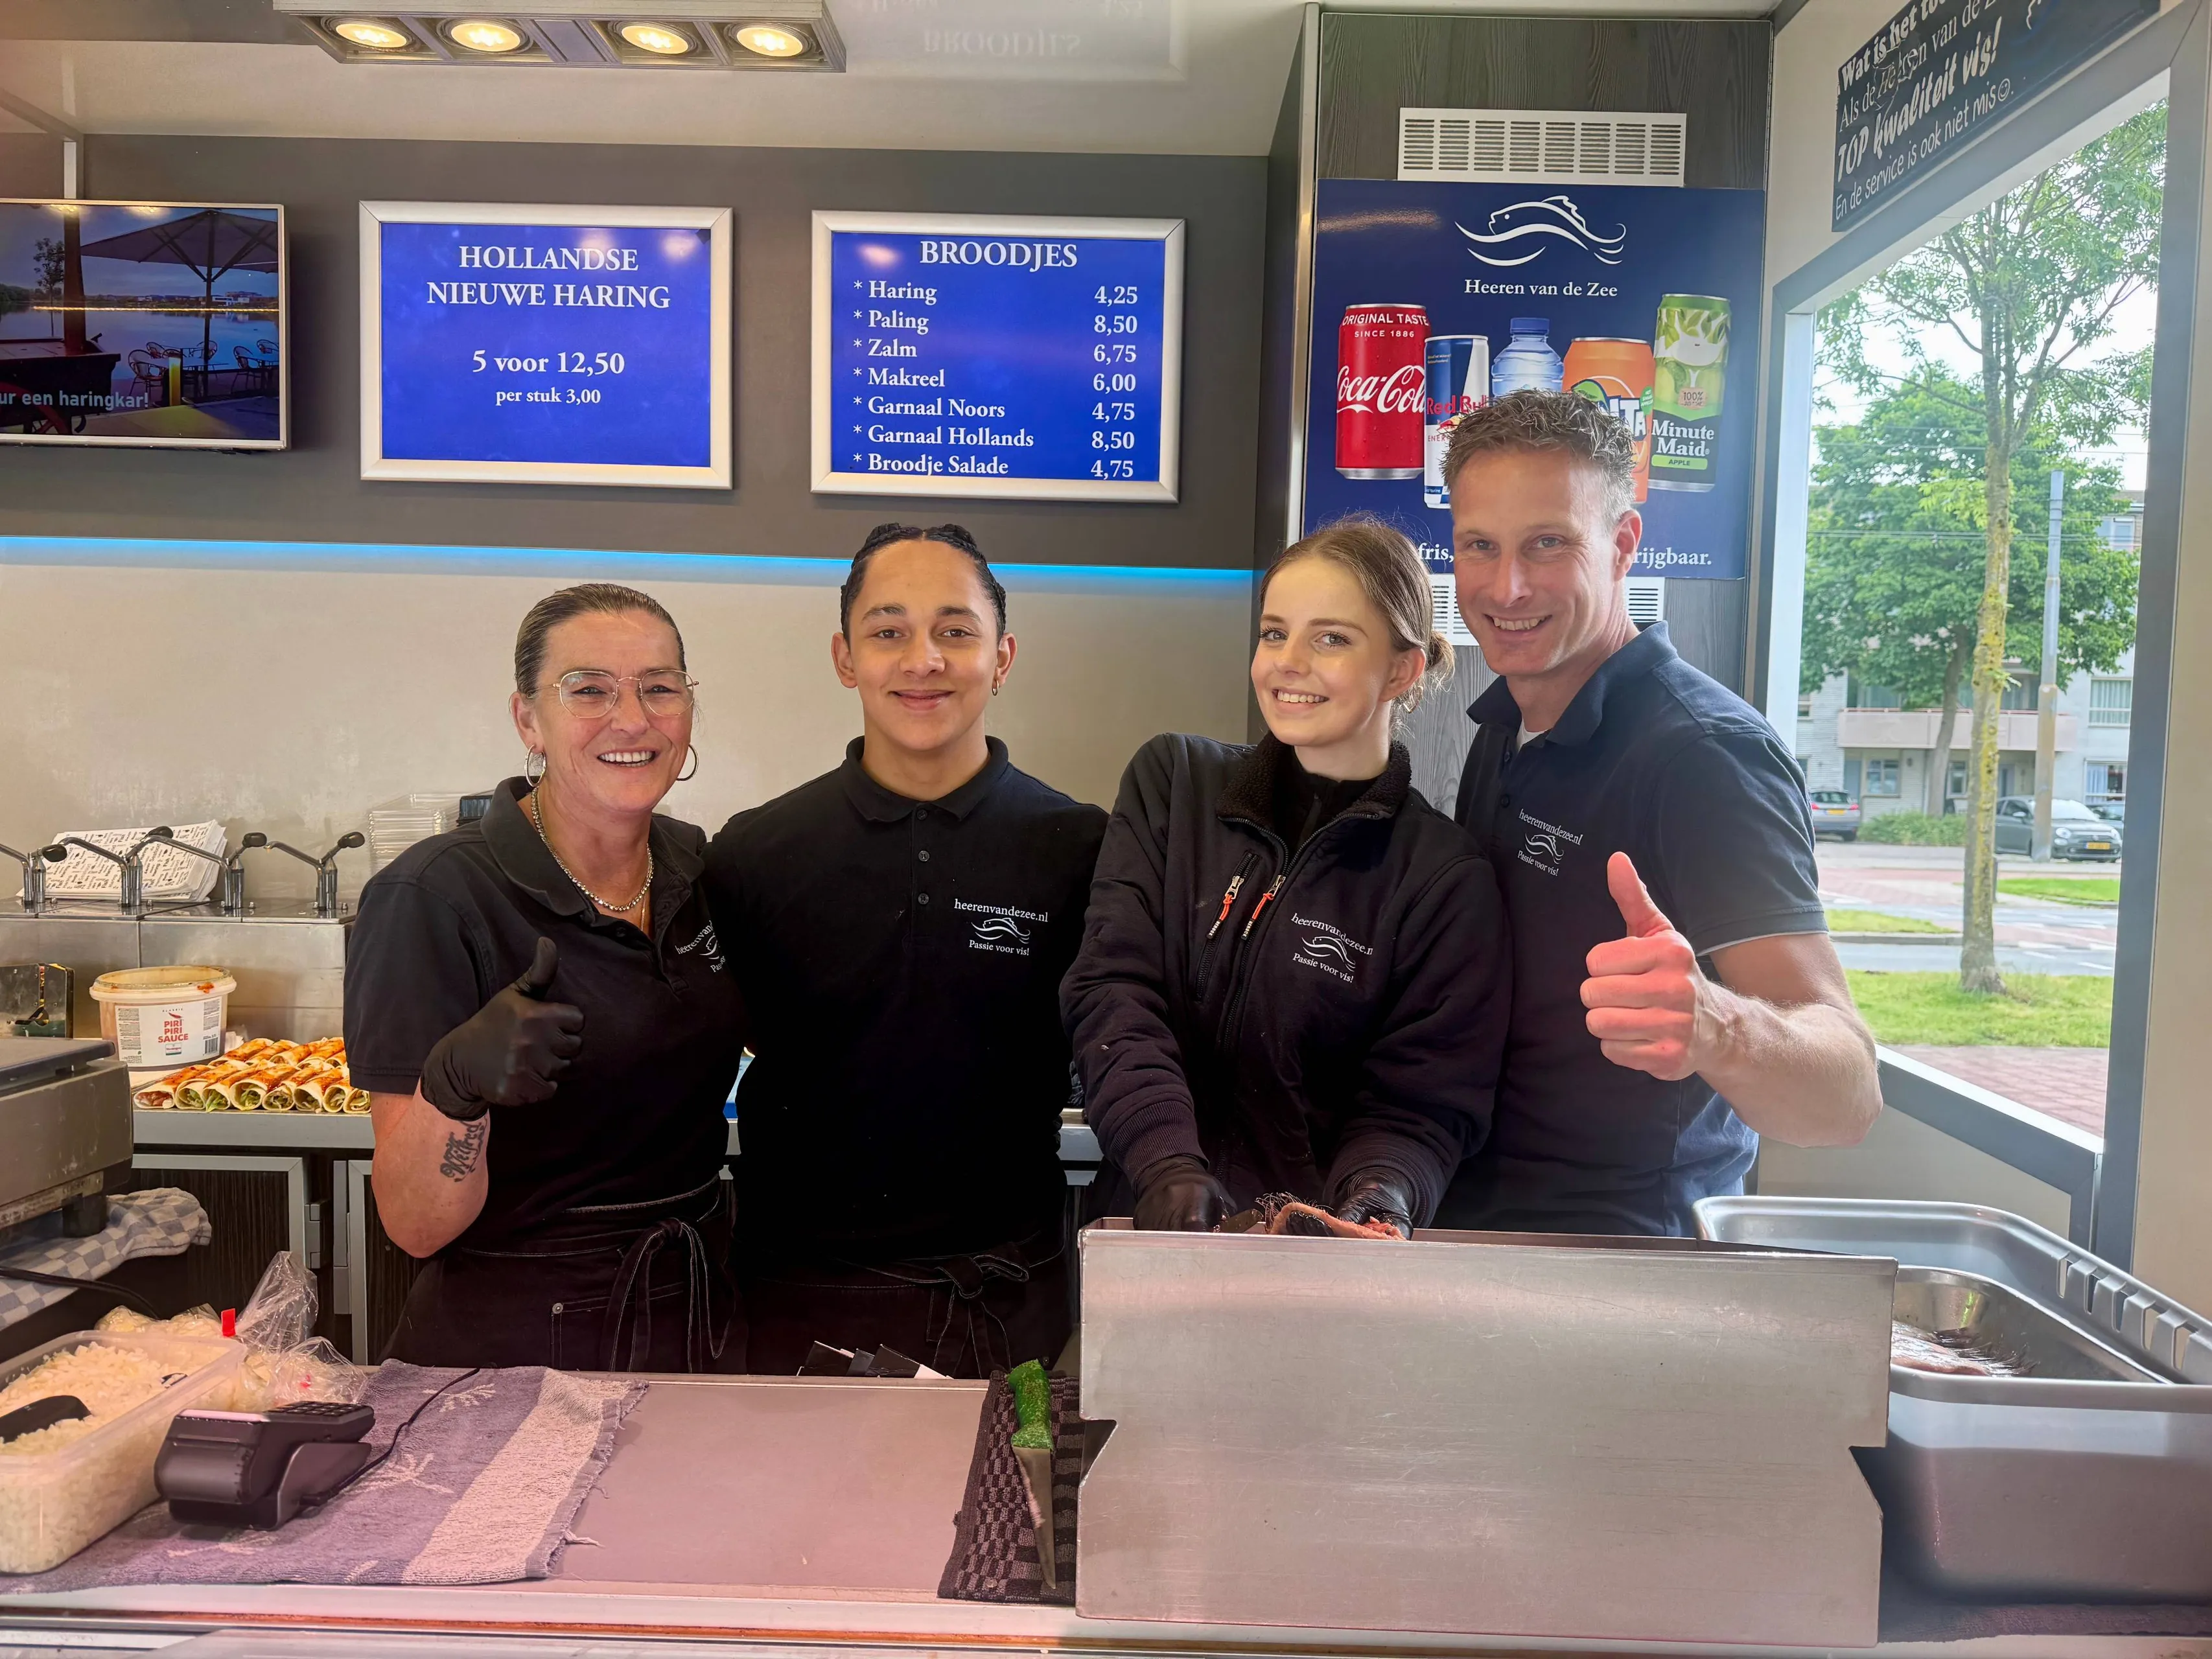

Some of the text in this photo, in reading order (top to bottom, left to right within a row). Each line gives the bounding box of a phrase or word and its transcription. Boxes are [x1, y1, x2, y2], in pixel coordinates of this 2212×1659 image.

[1842, 47, 1870, 91] Wat
[1874, 36, 1887, 64] is
[1890, 5, 1917, 49] het
[1841, 97, 1859, 135] Als
[1863, 82, 1876, 112] de
[1932, 16, 1957, 52] van
[1837, 16, 2002, 182] TOP kwaliteit vis!
[1835, 194, 1846, 220] En
[1850, 182, 1861, 210] de
[1865, 154, 1903, 199] service
[1907, 141, 1916, 170] is
[1920, 121, 1941, 158] ook
[1944, 99, 1969, 142] niet
[460, 246, 638, 271] HOLLANDSE
[920, 241, 1078, 273] BROODJES
[426, 282, 671, 309] NIEUWE HARING
[868, 281, 1138, 307] Haring 4,25
[1464, 279, 1618, 297] Heeren van de Zee
[868, 310, 1138, 336] Paling 8,50
[1342, 314, 1429, 326] ORIGINAL TASTE
[472, 350, 625, 376] 5 voor 12,50
[868, 339, 1137, 365] Zalm 6,75
[867, 367, 1136, 394] Makreel 6,00
[1337, 365, 1425, 413] Coca-Col
[22, 393, 53, 406] een
[59, 390, 148, 411] haringkar!
[496, 388, 601, 406] per stuk 3,00
[1427, 394, 1456, 415] Red
[1683, 391, 1704, 400] 100%
[868, 397, 1135, 423] Garnaal Noors 4,75
[868, 425, 1135, 452] Garnaal Hollands 8,50
[1651, 419, 1714, 440] Minute
[868, 454, 1134, 481] Broodje Salade 4,75
[1633, 546, 1712, 570] rijgbaar.
[1519, 809, 1583, 845] heerenvandezee.nl
[1517, 850, 1559, 876] Passie voor vis!
[954, 898, 1048, 922] heerenvandezee.nl
[969, 940, 994, 950] Passie
[995, 945, 1014, 953] voor
[1292, 953, 1354, 982] Passie voor vis!
[158, 1034, 189, 1043] SAUCE
